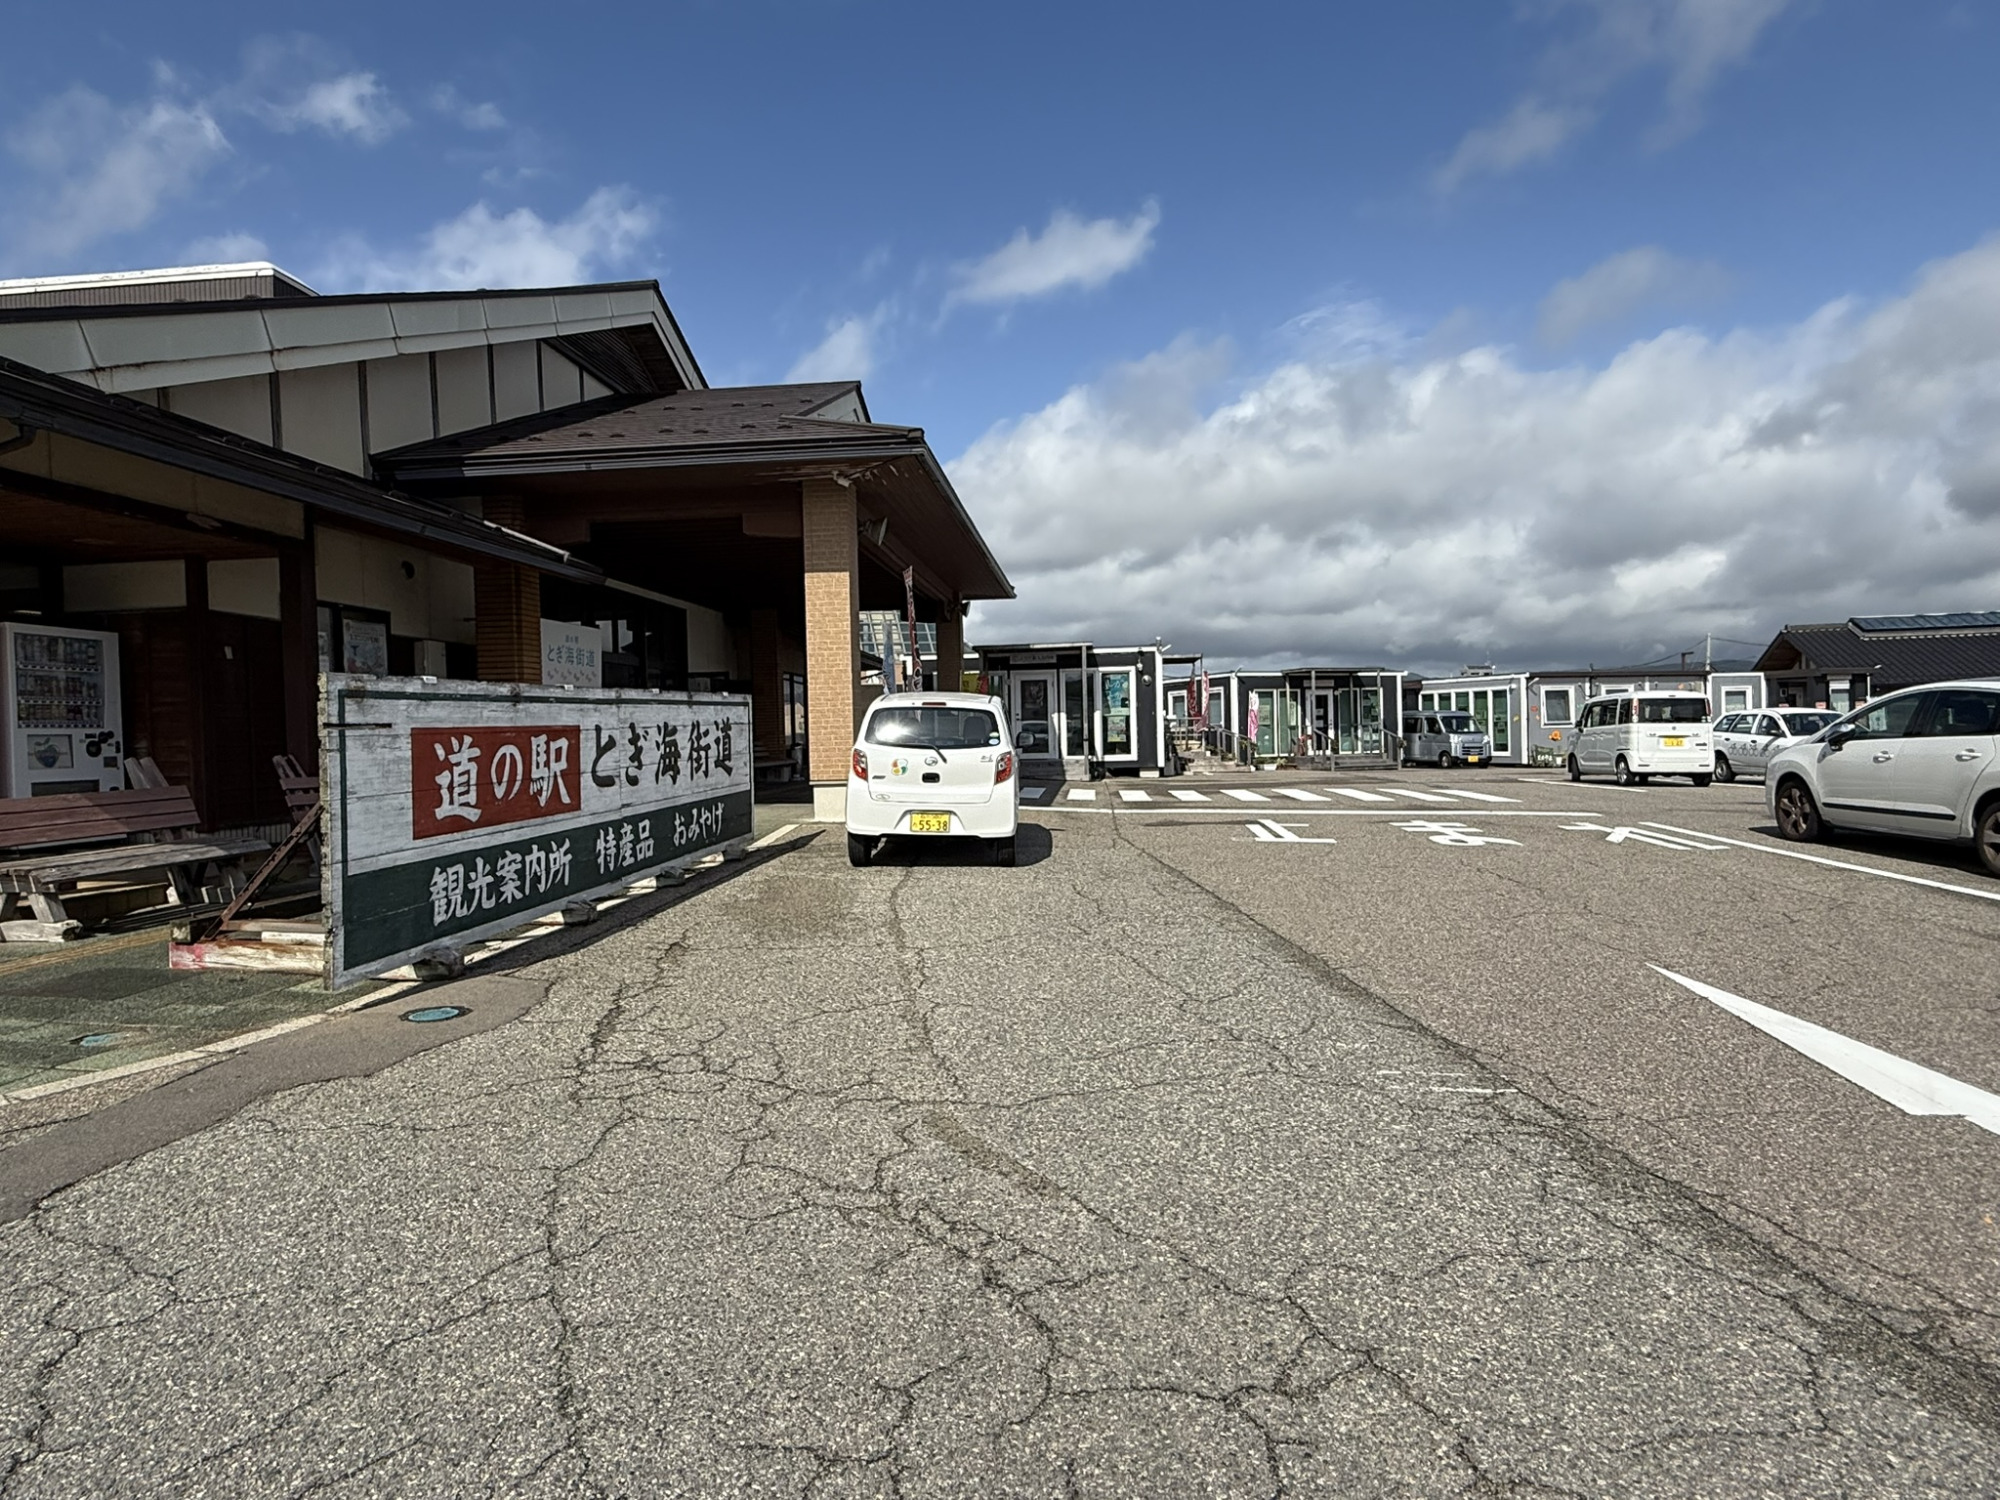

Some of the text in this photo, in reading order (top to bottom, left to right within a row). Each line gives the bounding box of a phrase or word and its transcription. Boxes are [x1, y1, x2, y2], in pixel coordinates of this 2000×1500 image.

[434, 717, 734, 823] 道の駅 とぎ海街道
[429, 803, 725, 927] 観光案内所 特産品 おみやげ
[918, 819, 948, 831] 55-38
